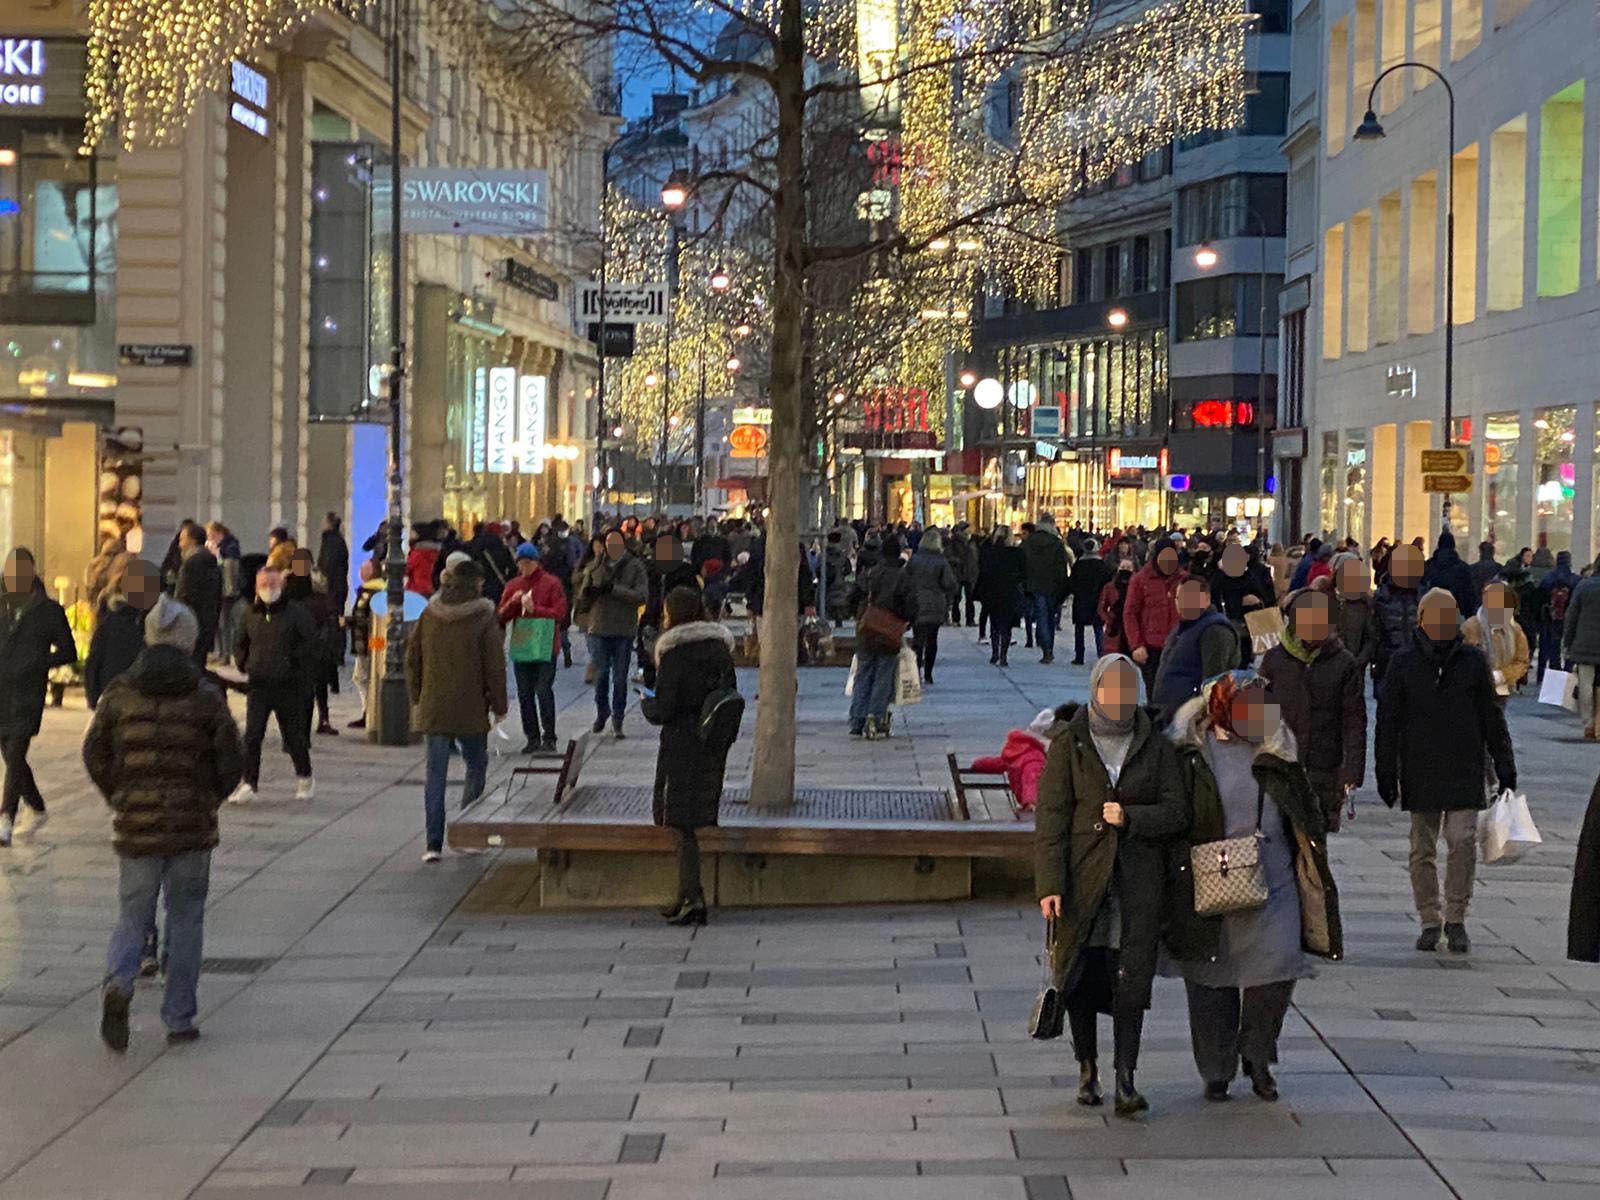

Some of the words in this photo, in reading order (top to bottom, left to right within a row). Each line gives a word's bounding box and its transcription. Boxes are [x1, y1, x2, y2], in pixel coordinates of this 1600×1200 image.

[0, 38, 44, 75] KI
[403, 180, 539, 204] SWAROVSKI
[493, 375, 508, 465] MANGO
[525, 382, 539, 466] MANGO
